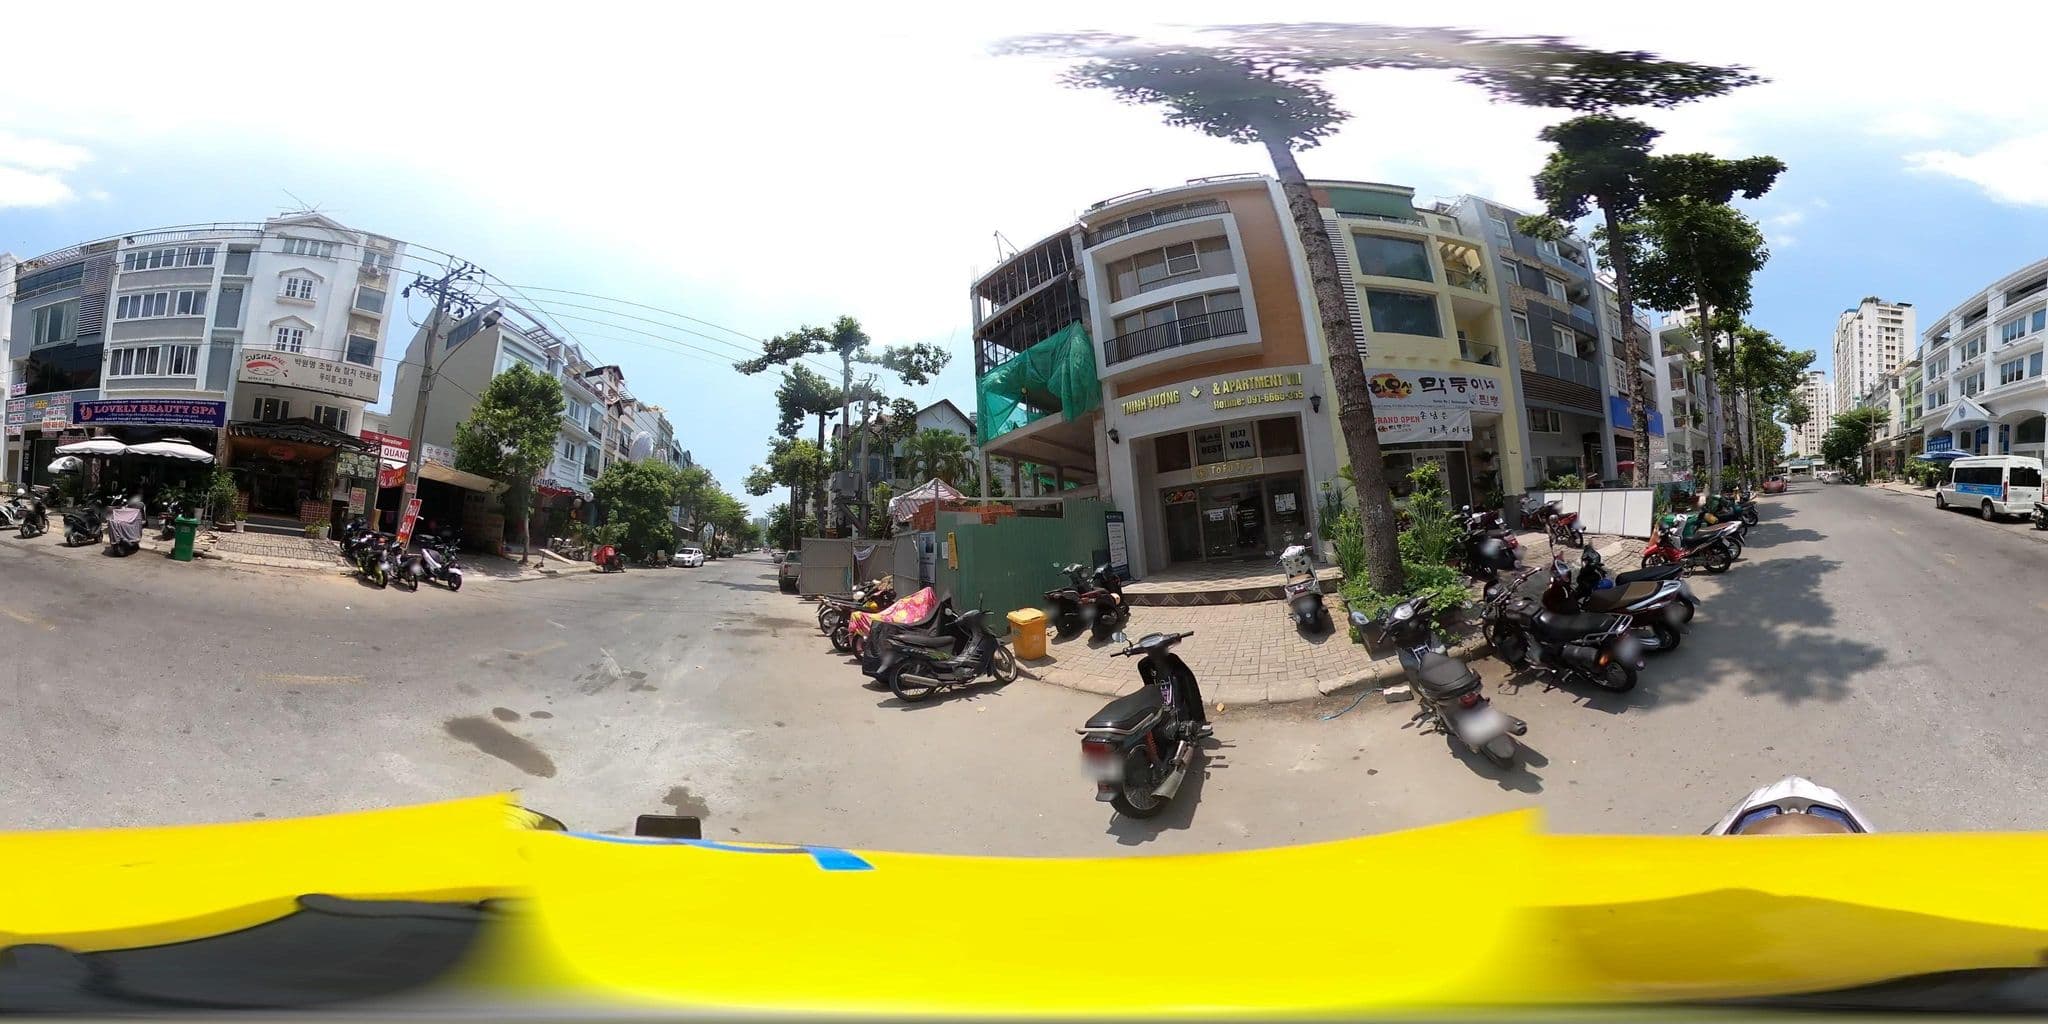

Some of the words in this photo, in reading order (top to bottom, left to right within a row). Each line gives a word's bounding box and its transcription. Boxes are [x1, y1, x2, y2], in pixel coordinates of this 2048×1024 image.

[1212, 382, 1221, 396] &
[1222, 374, 1283, 394] APARTMENT
[94, 405, 138, 414] LOVELY
[140, 404, 190, 414] BEAUTY
[191, 405, 217, 416] SPA
[1213, 398, 1246, 410] Hotline:
[1400, 416, 1421, 424] OPEN
[1229, 440, 1251, 450] VISA
